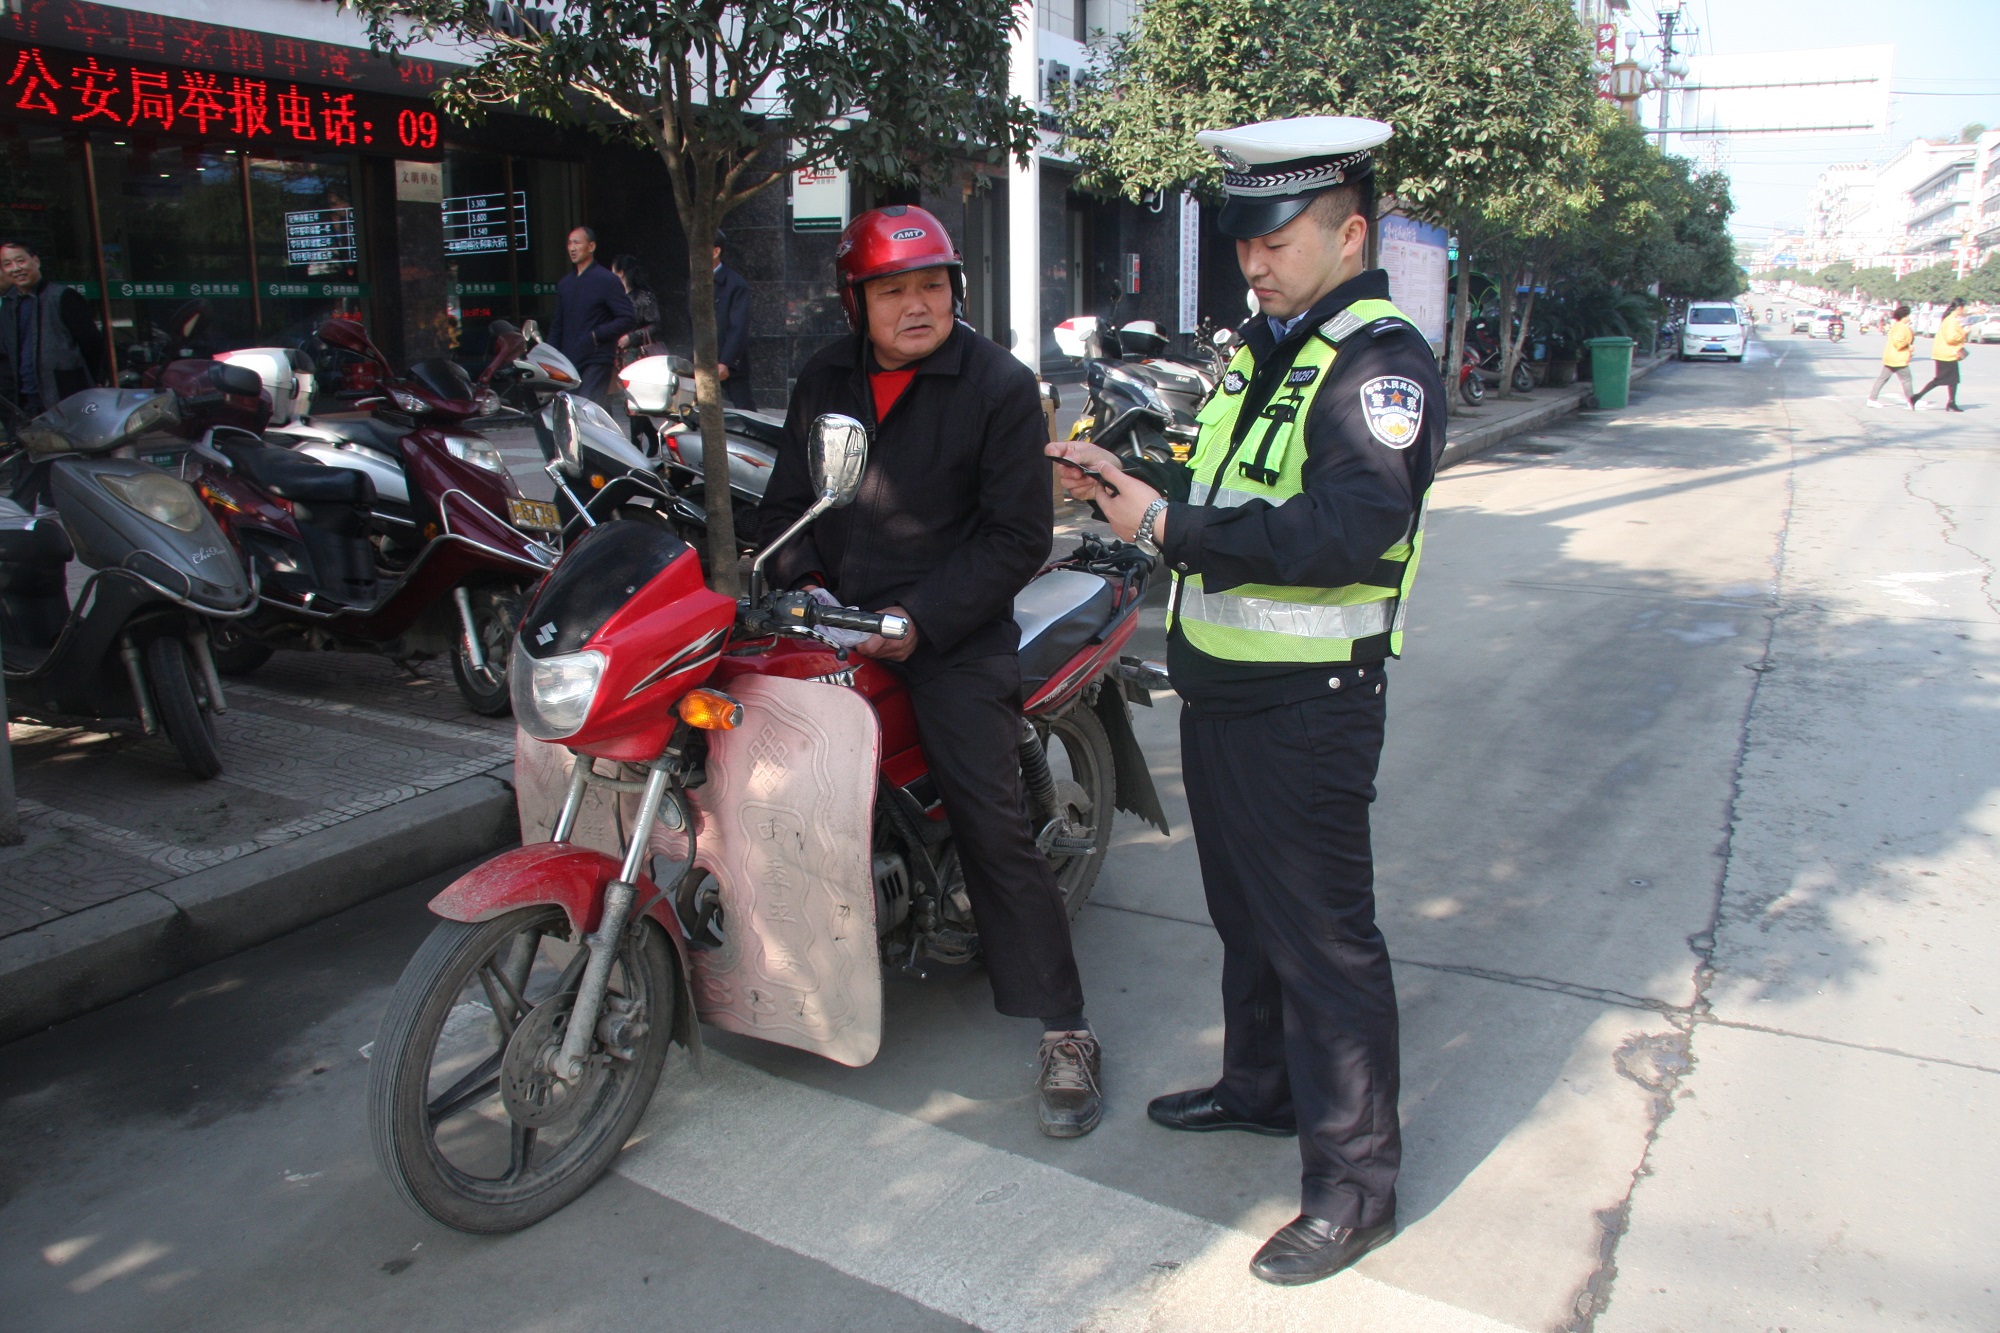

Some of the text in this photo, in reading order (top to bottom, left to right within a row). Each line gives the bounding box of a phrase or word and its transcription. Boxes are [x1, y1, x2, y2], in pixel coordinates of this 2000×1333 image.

[402, 171, 439, 185] 文明单位
[896, 230, 921, 240] AMT
[1365, 380, 1420, 399] 中华人民共和国
